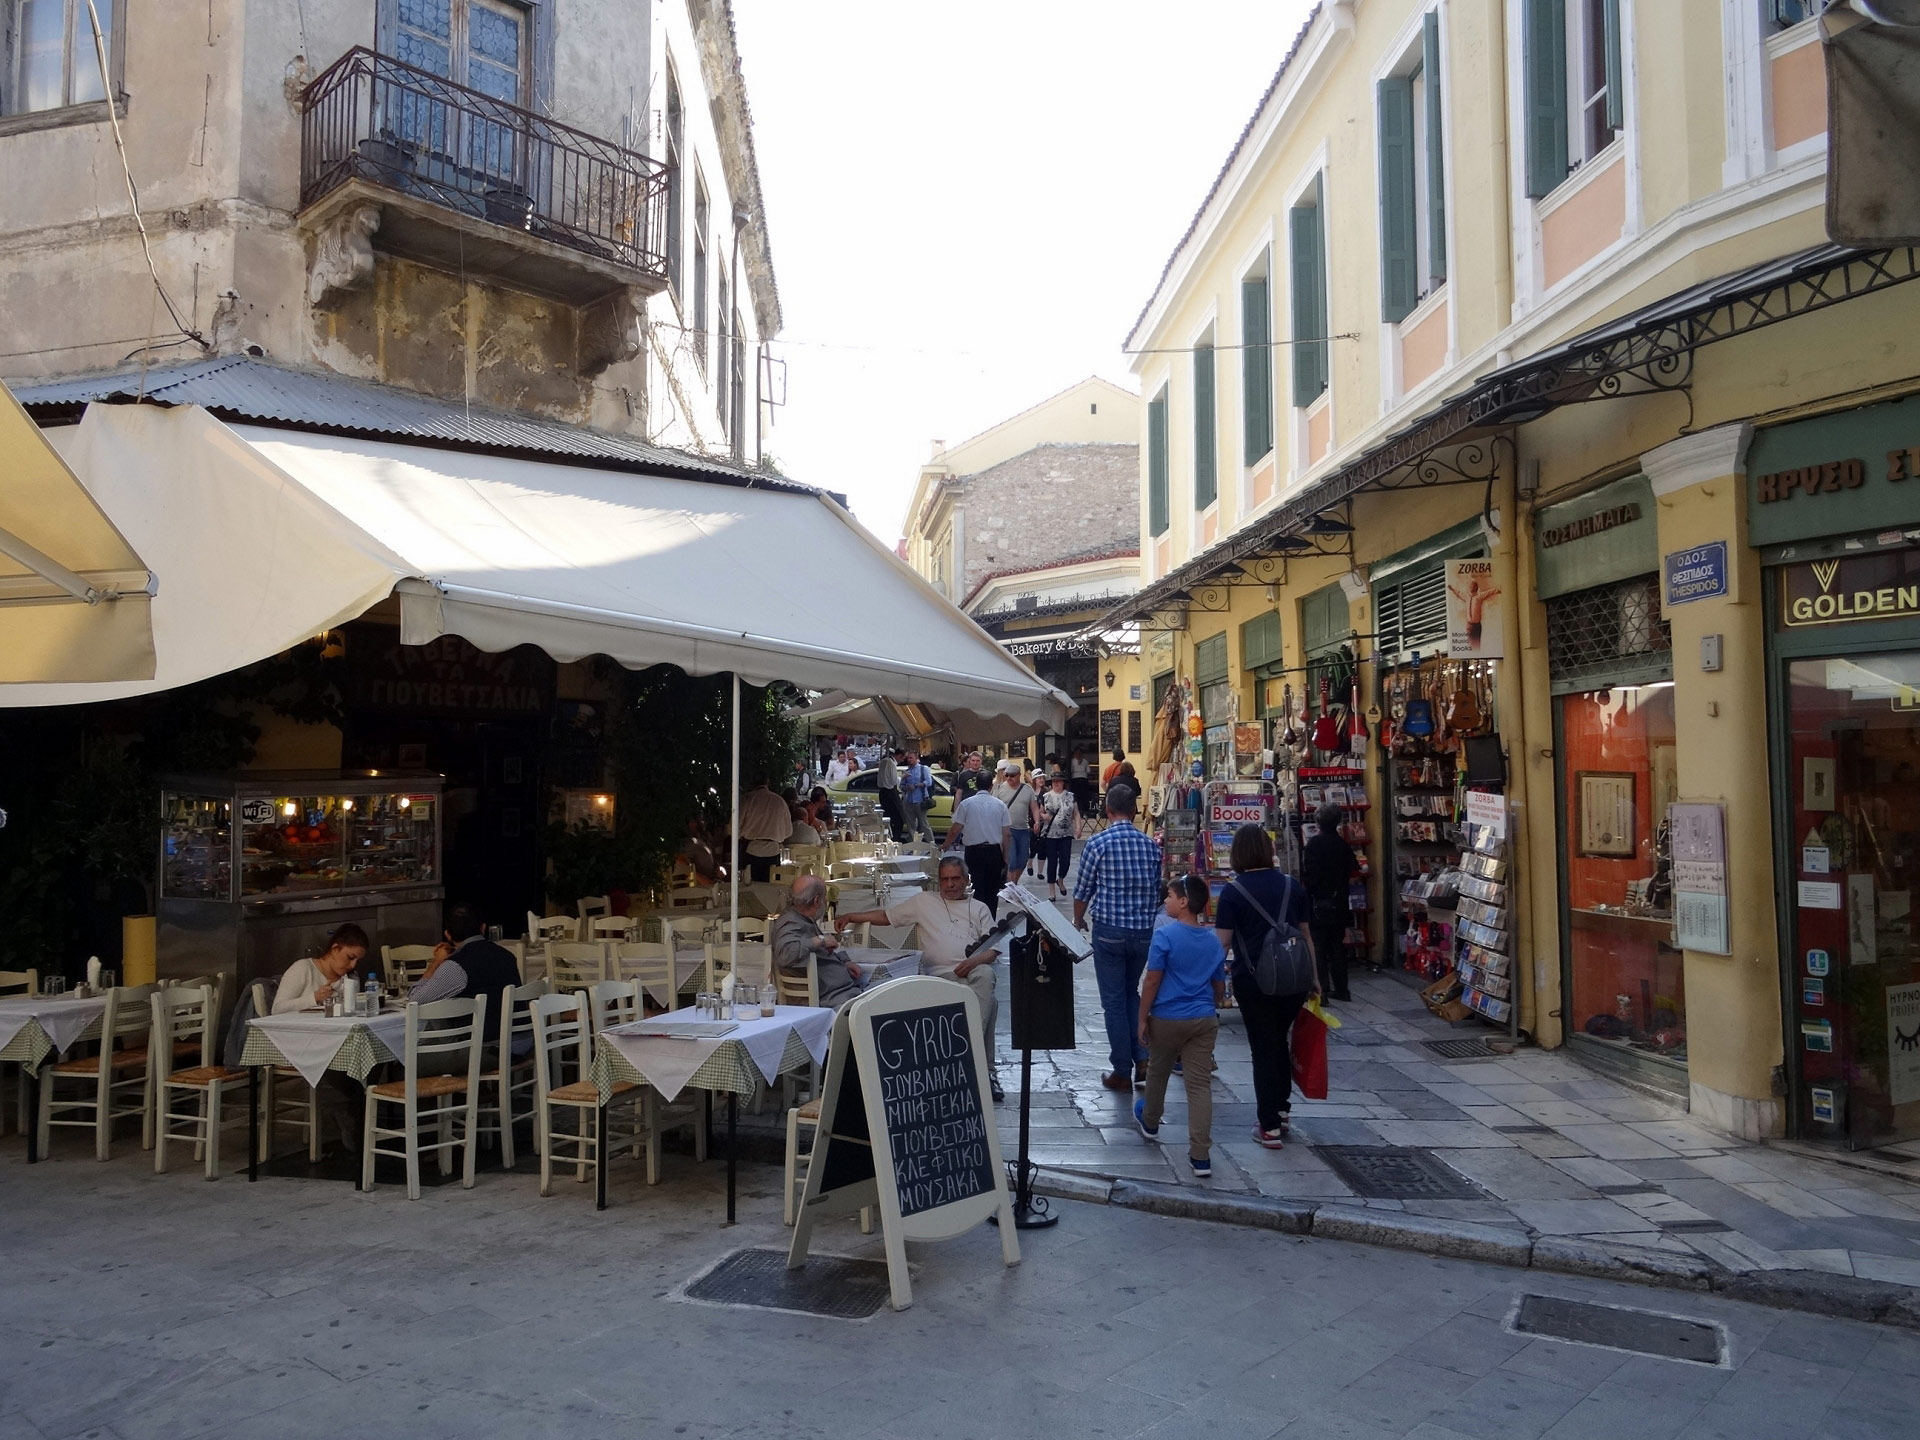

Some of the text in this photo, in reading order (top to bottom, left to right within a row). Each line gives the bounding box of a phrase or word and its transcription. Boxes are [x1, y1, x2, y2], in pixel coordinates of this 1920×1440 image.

[1541, 503, 1639, 548] ΚΟΣΜΗΜΑΤΑ
[1457, 562, 1492, 574] ZORBA
[1671, 564, 1714, 583] ΘΕΣΠΙΔΟΣ
[1677, 550, 1708, 567] ΟΔΟΣ
[1671, 578, 1719, 598] THESPIDOS
[1792, 586, 1918, 620] GOLDEN
[1010, 641, 1054, 656] Bakery
[1055, 638, 1067, 651] &
[1213, 807, 1260, 821] Books
[1474, 793, 1496, 805] ZORBA
[877, 1012, 969, 1070] GYROS
[883, 1060, 968, 1102] ΣΟΥΒΛΑΚΙΑ
[887, 1088, 976, 1128] ΜΠΙΦΤΕΚΙΑ
[890, 1113, 986, 1159] ΓΙΟΥΒΕΤΣΑΚΙ
[895, 1143, 983, 1185] ΚΛΕΦΤΙΚΟ
[900, 1169, 980, 1213] ΜΟΥΣΑΚΑ
